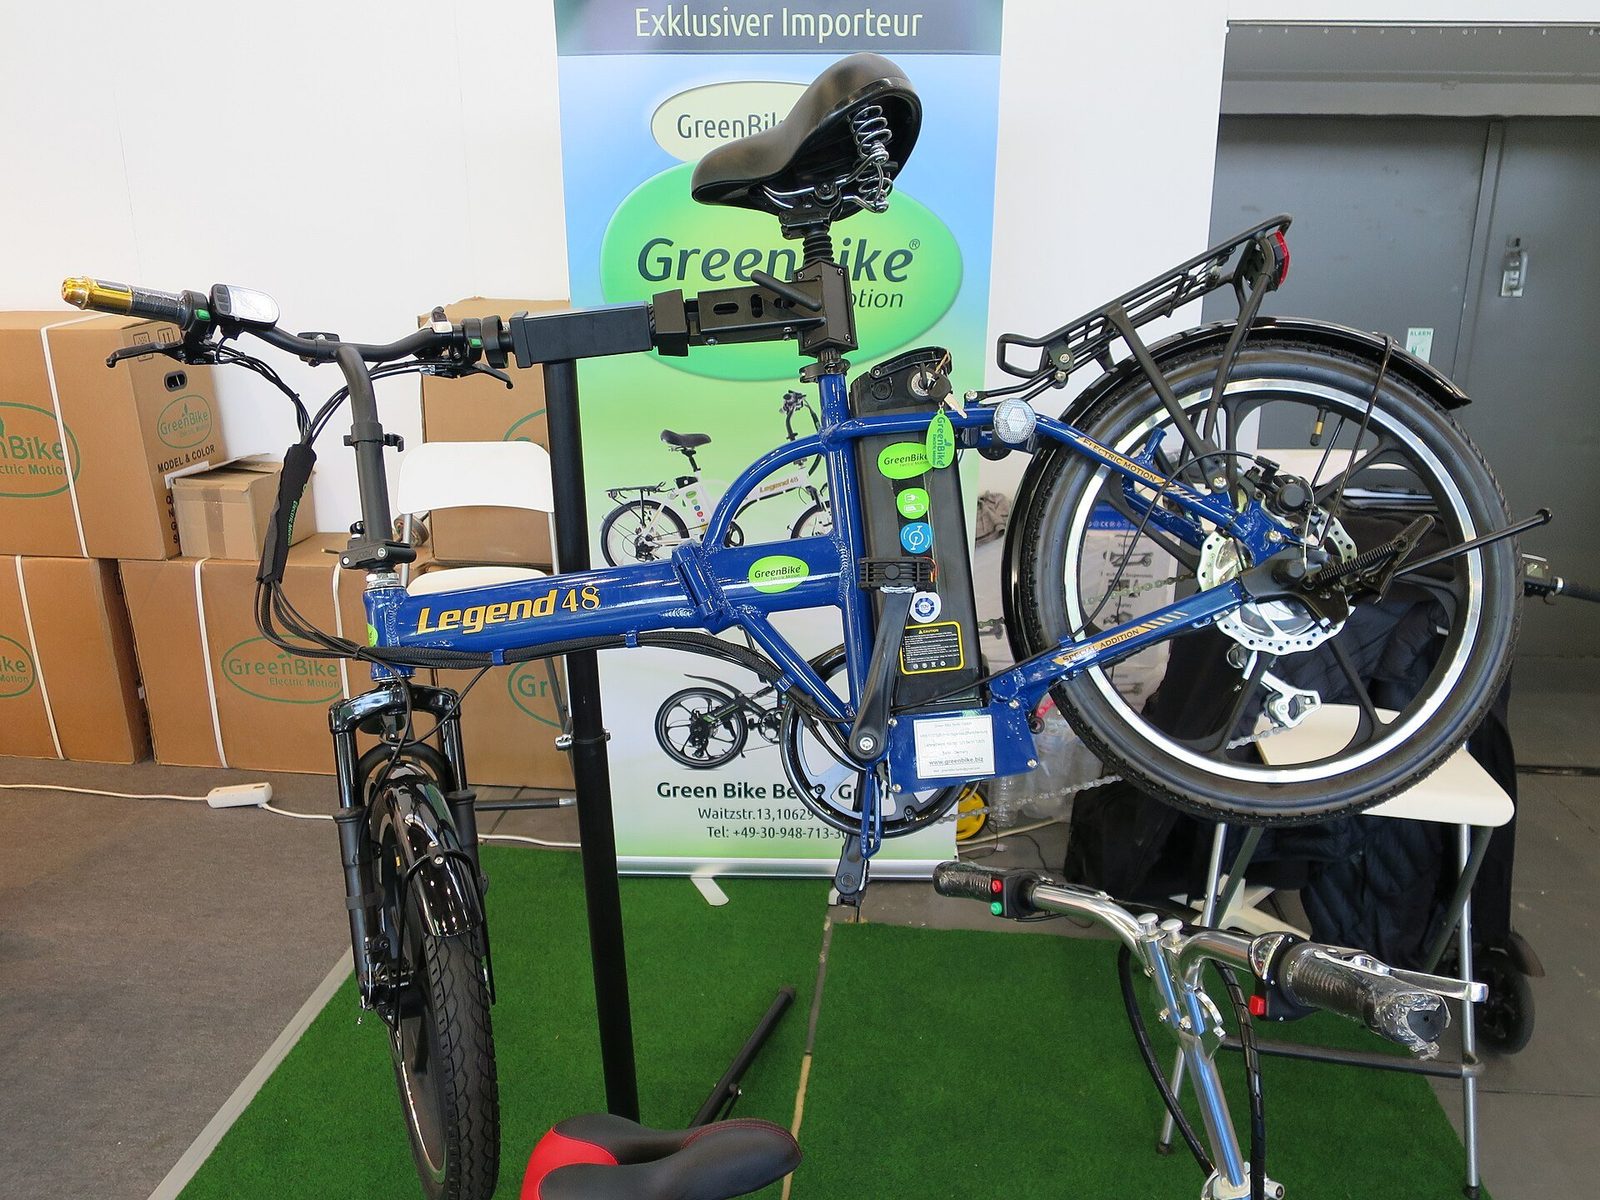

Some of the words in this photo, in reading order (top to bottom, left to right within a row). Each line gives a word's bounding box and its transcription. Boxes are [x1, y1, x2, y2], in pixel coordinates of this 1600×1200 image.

[635, 5, 774, 37] Exklusiver
[782, 7, 923, 43] Importeur
[638, 238, 913, 282] Greenike
[160, 411, 208, 435] GreenBike
[937, 416, 945, 466] GreenBike
[157, 456, 183, 474] MODEL
[185, 454, 190, 463] &
[192, 444, 215, 460] COLOR
[1083, 438, 1124, 464] ELECTRIC
[1122, 462, 1156, 482] MOTION
[755, 565, 801, 578] GreenBike
[416, 589, 557, 634] Legend
[561, 586, 600, 612] 48
[1100, 628, 1139, 648] ADDITION
[229, 659, 337, 677] GreenBike
[269, 677, 304, 686] Electric
[307, 678, 339, 688] Motion
[657, 782, 717, 799] Green
[723, 782, 766, 799] Bike
[707, 826, 729, 838] Tel:
